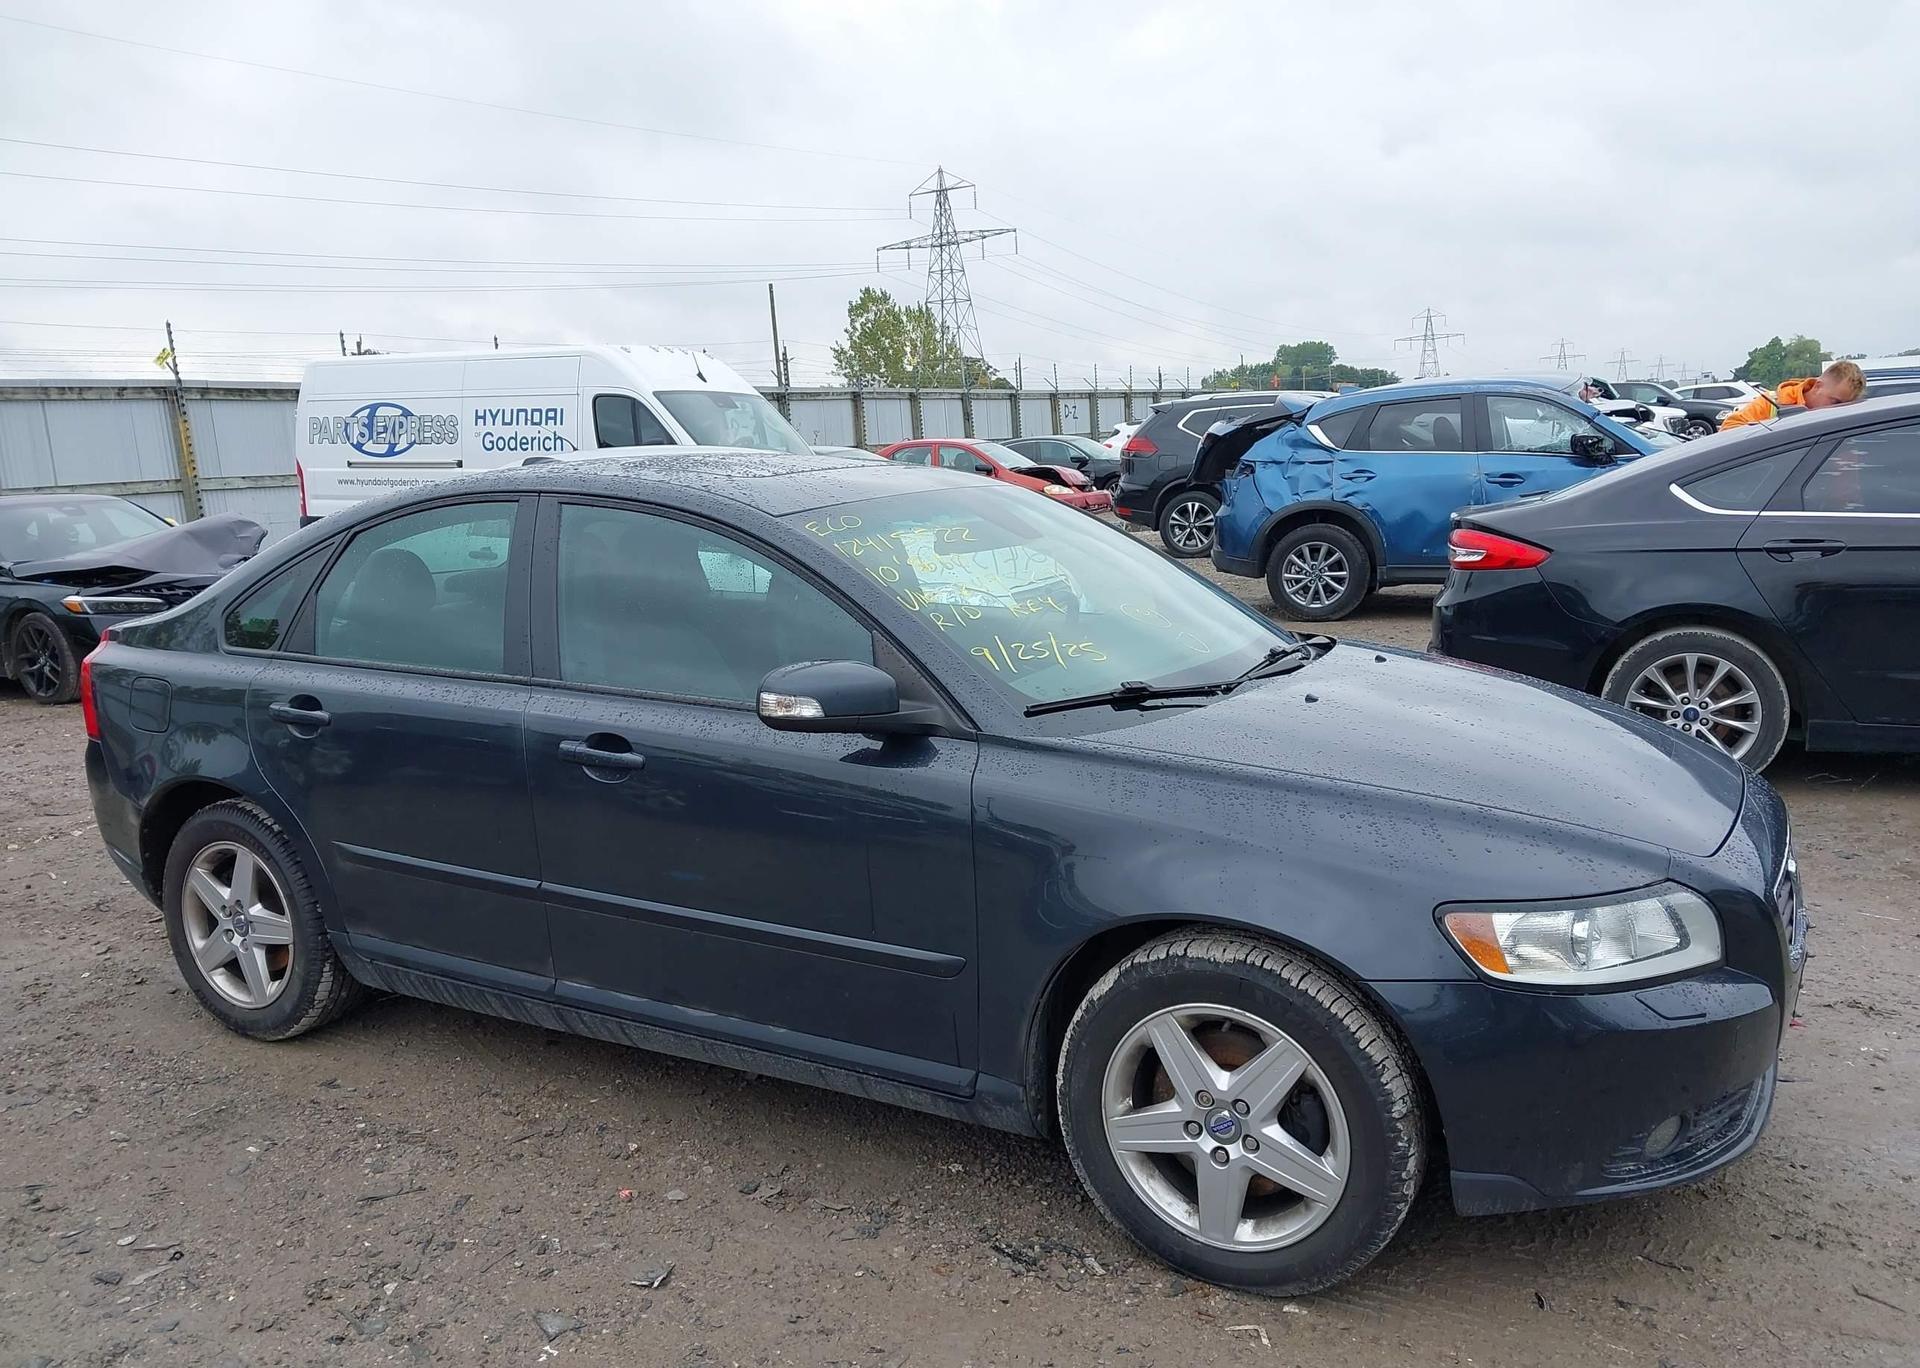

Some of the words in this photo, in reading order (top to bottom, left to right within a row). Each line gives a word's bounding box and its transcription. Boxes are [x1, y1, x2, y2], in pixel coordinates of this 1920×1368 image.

[474, 407, 564, 426] HYUNDAI
[309, 416, 369, 444] PARTS
[372, 415, 459, 445] EXPRESS
[482, 430, 564, 451] Goderich
[805, 515, 862, 537] ECO
[970, 631, 1107, 673] 9/25/25
